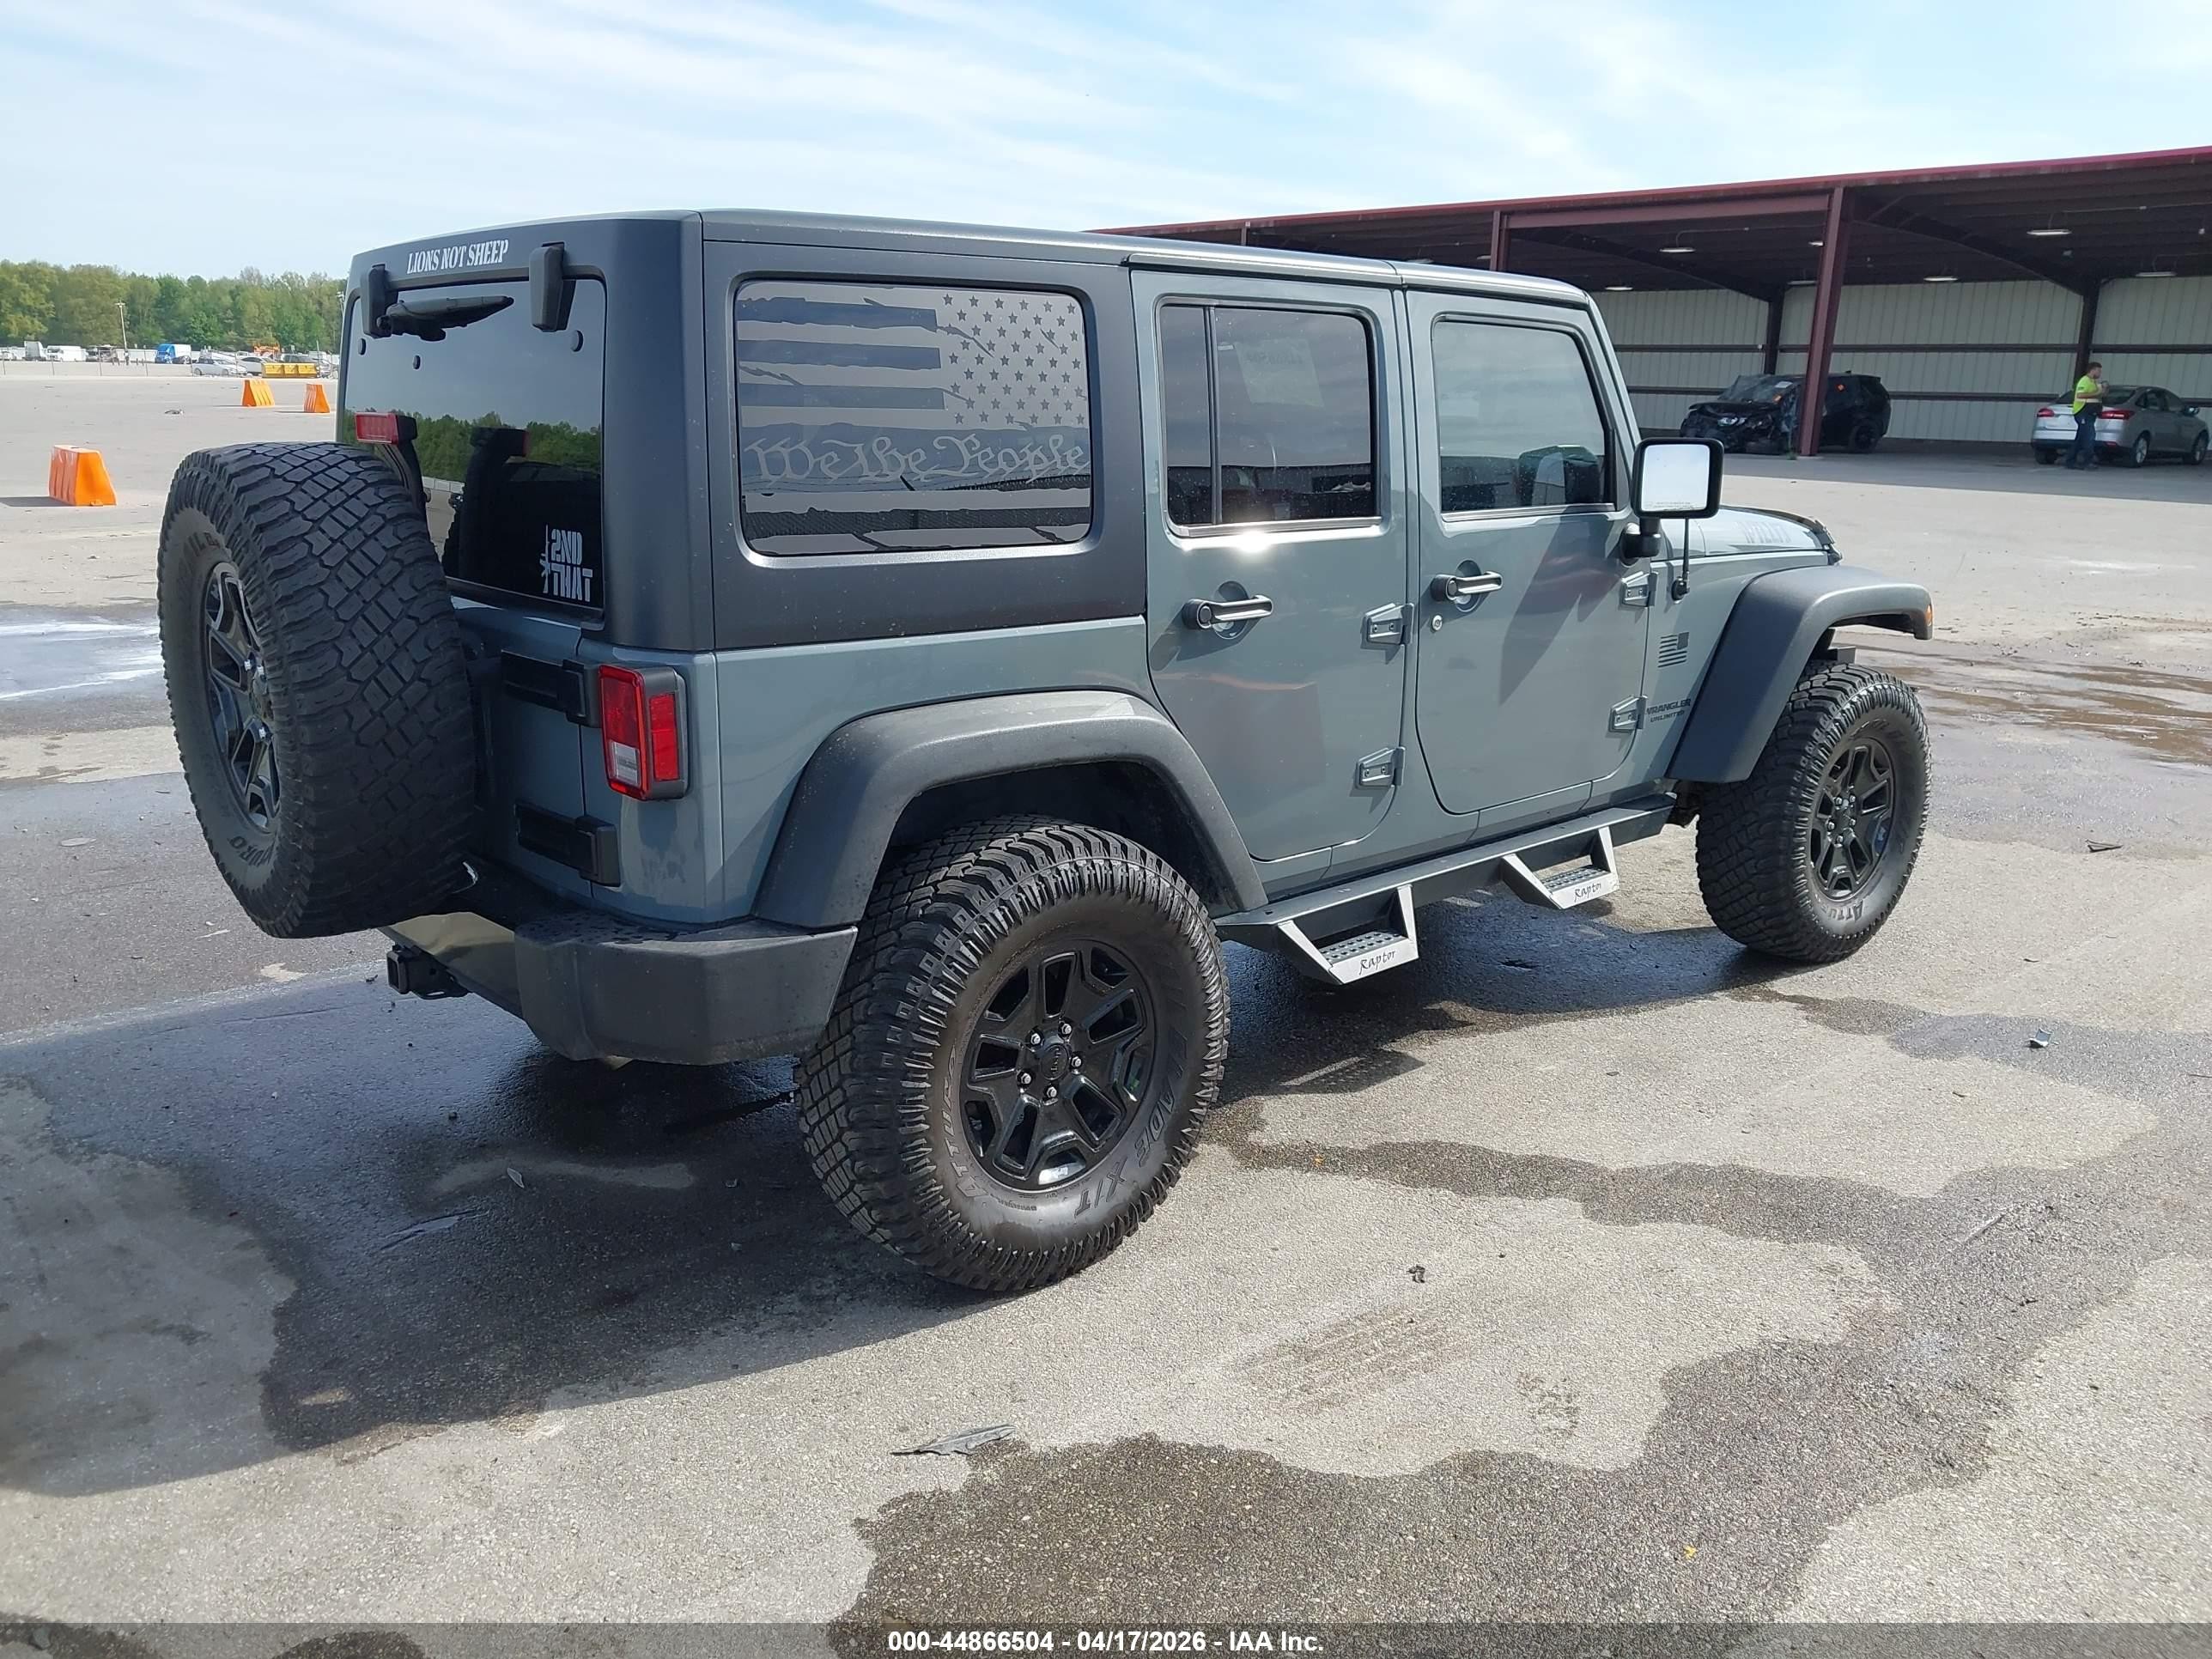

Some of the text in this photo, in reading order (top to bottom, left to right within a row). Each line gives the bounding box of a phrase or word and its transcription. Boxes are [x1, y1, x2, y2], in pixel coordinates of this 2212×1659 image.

[406, 239, 509, 274] LIONS NOT SHEEP
[744, 433, 1091, 483] We The People
[550, 528, 583, 565] 2ND
[550, 562, 593, 602] THAT
[1646, 698, 1692, 714] WRANGLER
[1574, 881, 1602, 902] Raptor
[1359, 948, 1396, 975] Raptor
